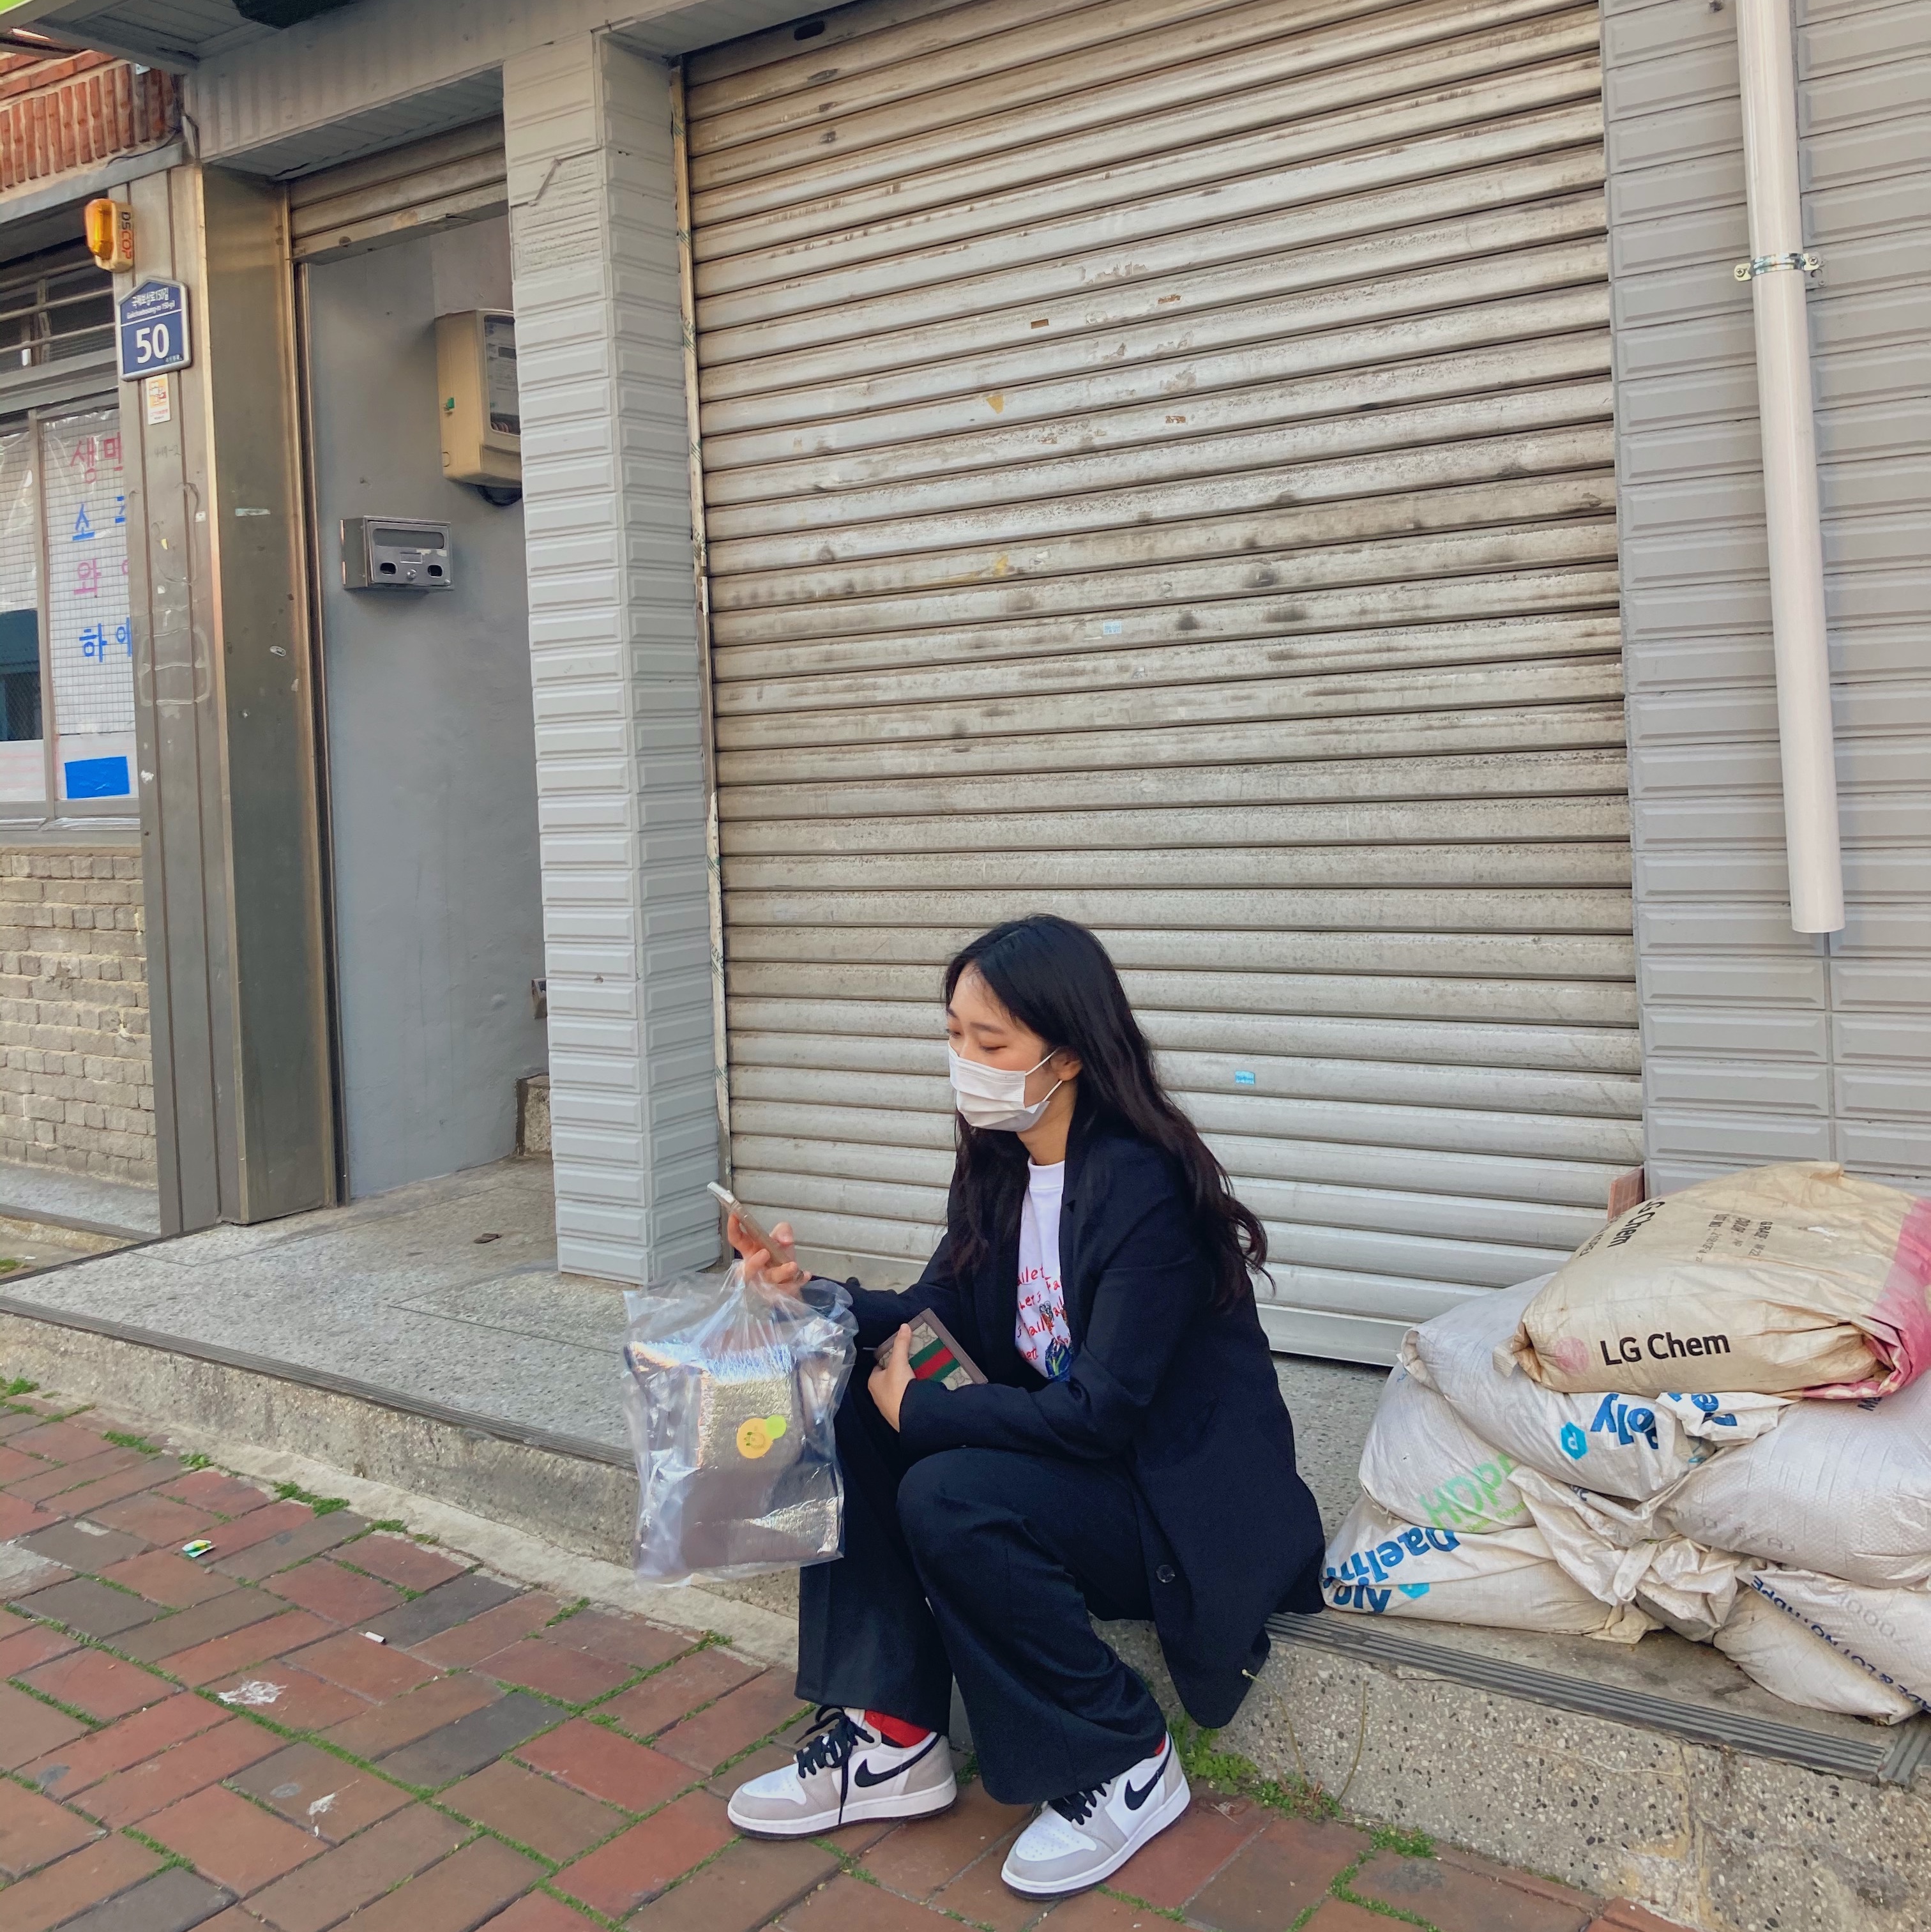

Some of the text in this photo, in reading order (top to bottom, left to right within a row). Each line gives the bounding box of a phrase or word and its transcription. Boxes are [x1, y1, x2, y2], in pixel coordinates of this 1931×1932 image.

[136, 323, 169, 364] 50
[1607, 1212, 1656, 1248] Chem
[1600, 1332, 1731, 1366] LG Chem
